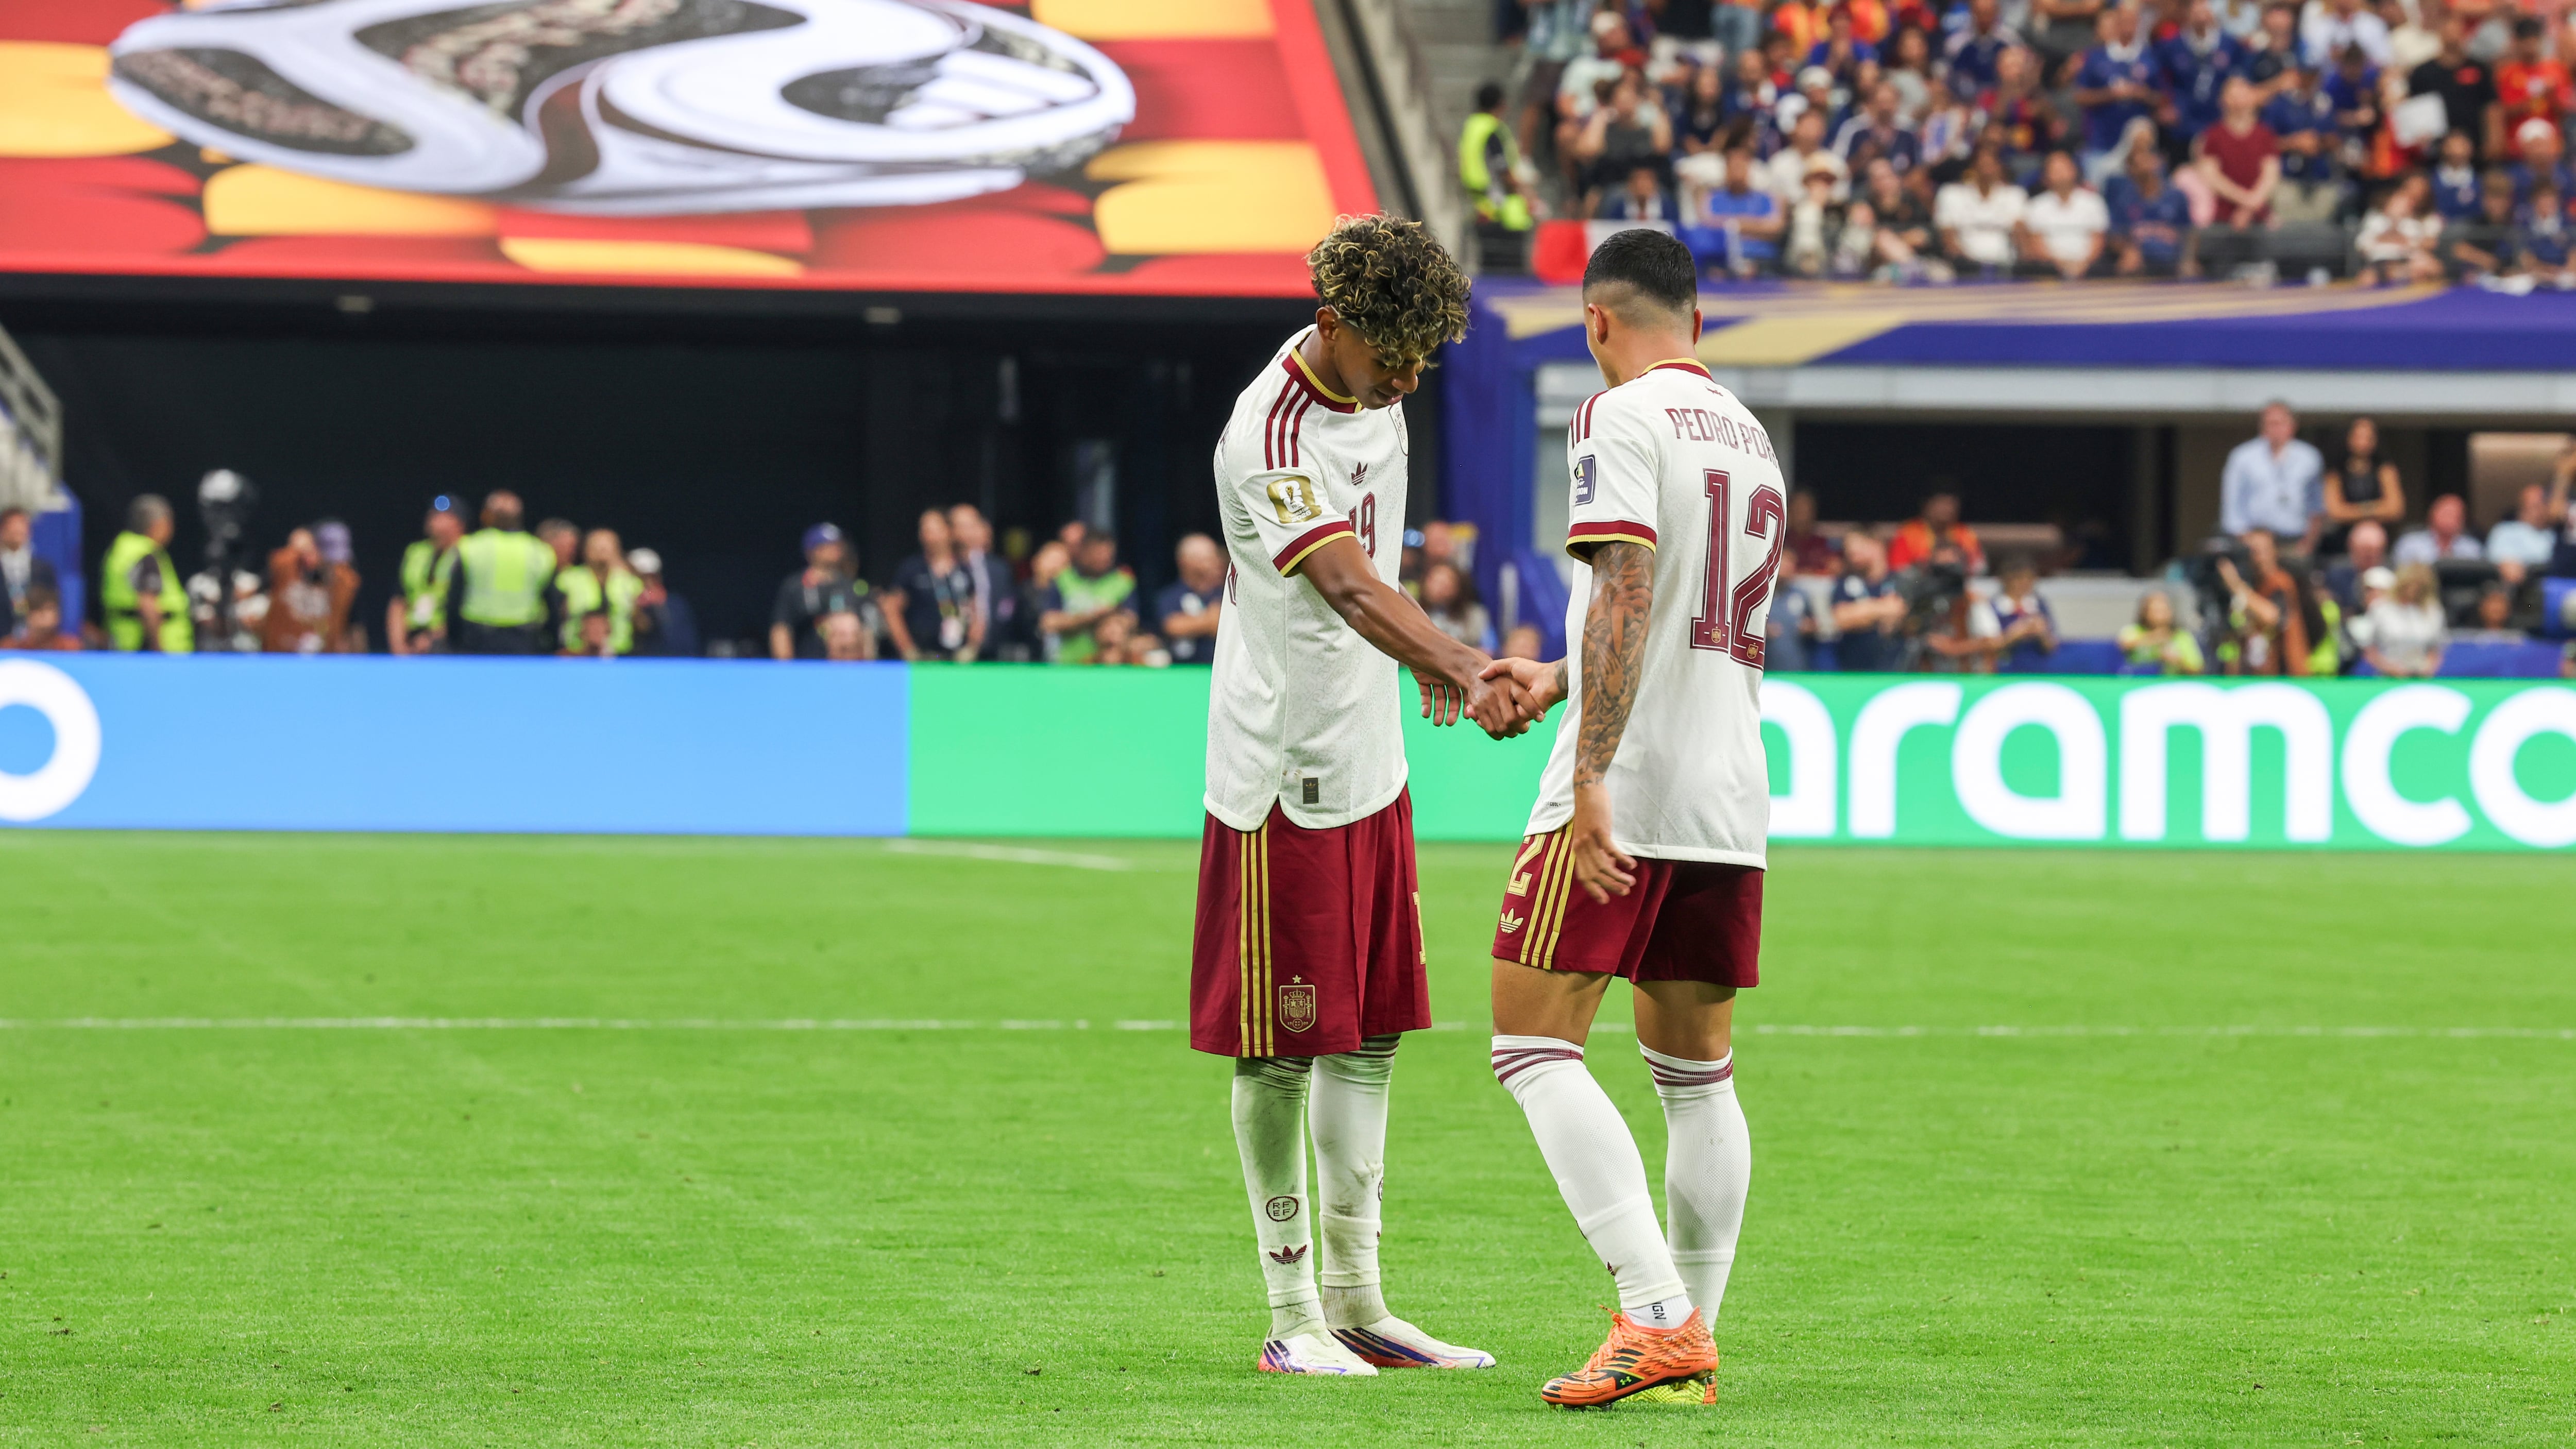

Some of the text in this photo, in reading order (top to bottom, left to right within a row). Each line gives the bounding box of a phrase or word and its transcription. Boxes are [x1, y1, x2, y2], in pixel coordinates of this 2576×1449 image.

[1665, 408, 1739, 450] PEDRO
[1349, 491, 1376, 560] 19
[1690, 468, 1787, 671] 12
